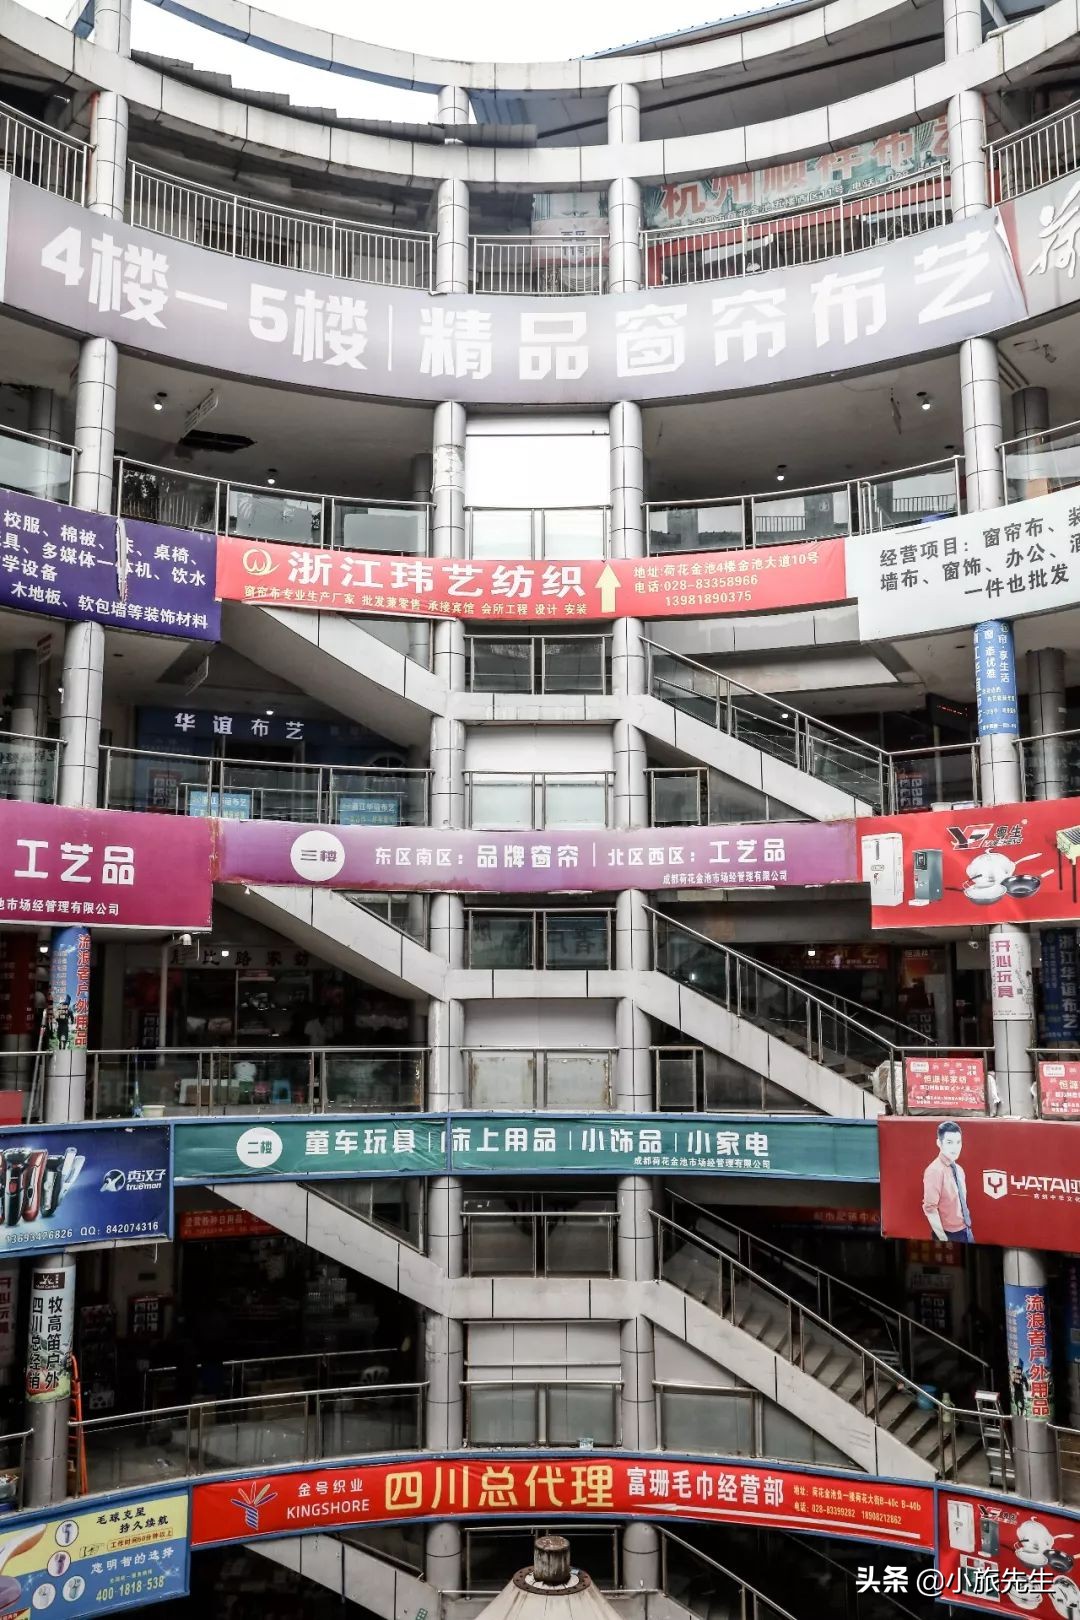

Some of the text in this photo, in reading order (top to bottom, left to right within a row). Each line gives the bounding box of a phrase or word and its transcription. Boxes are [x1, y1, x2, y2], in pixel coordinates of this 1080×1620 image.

[419, 232, 995, 381] 精品窗帘布艺
[287, 551, 586, 598] 浙江玮艺纺织
[964, 564, 1069, 599] 一件也批发
[427, 602, 475, 615] 承接宾馆
[481, 603, 529, 616] 会所工程
[535, 604, 557, 615] 设计
[564, 603, 588, 615] 安装
[665, 591, 752, 607] 13981890375
[174, 713, 304, 740] 华谊布艺
[14, 839, 135, 885] 工艺品
[300, 849, 337, 863] 三楼
[75, 934, 91, 1046] 流浪者户外用品
[247, 1141, 272, 1154] 二楼
[305, 1127, 769, 1156] 童车玩具 床上用品 小饰品 小家电
[106, 1222, 159, 1233] 842074316
[45, 1296, 63, 1389] 牧高笛户外
[1025, 1294, 1050, 1416] 流浪者户外用品
[298, 1478, 363, 1497] 金号织业
[385, 1465, 784, 1511] 四川总代理 富珊毛巾经营部
[97, 1507, 146, 1524] 毛球克星
[287, 1499, 370, 1519] KINGSHORE
[91, 1547, 174, 1574] 您明智的选择
